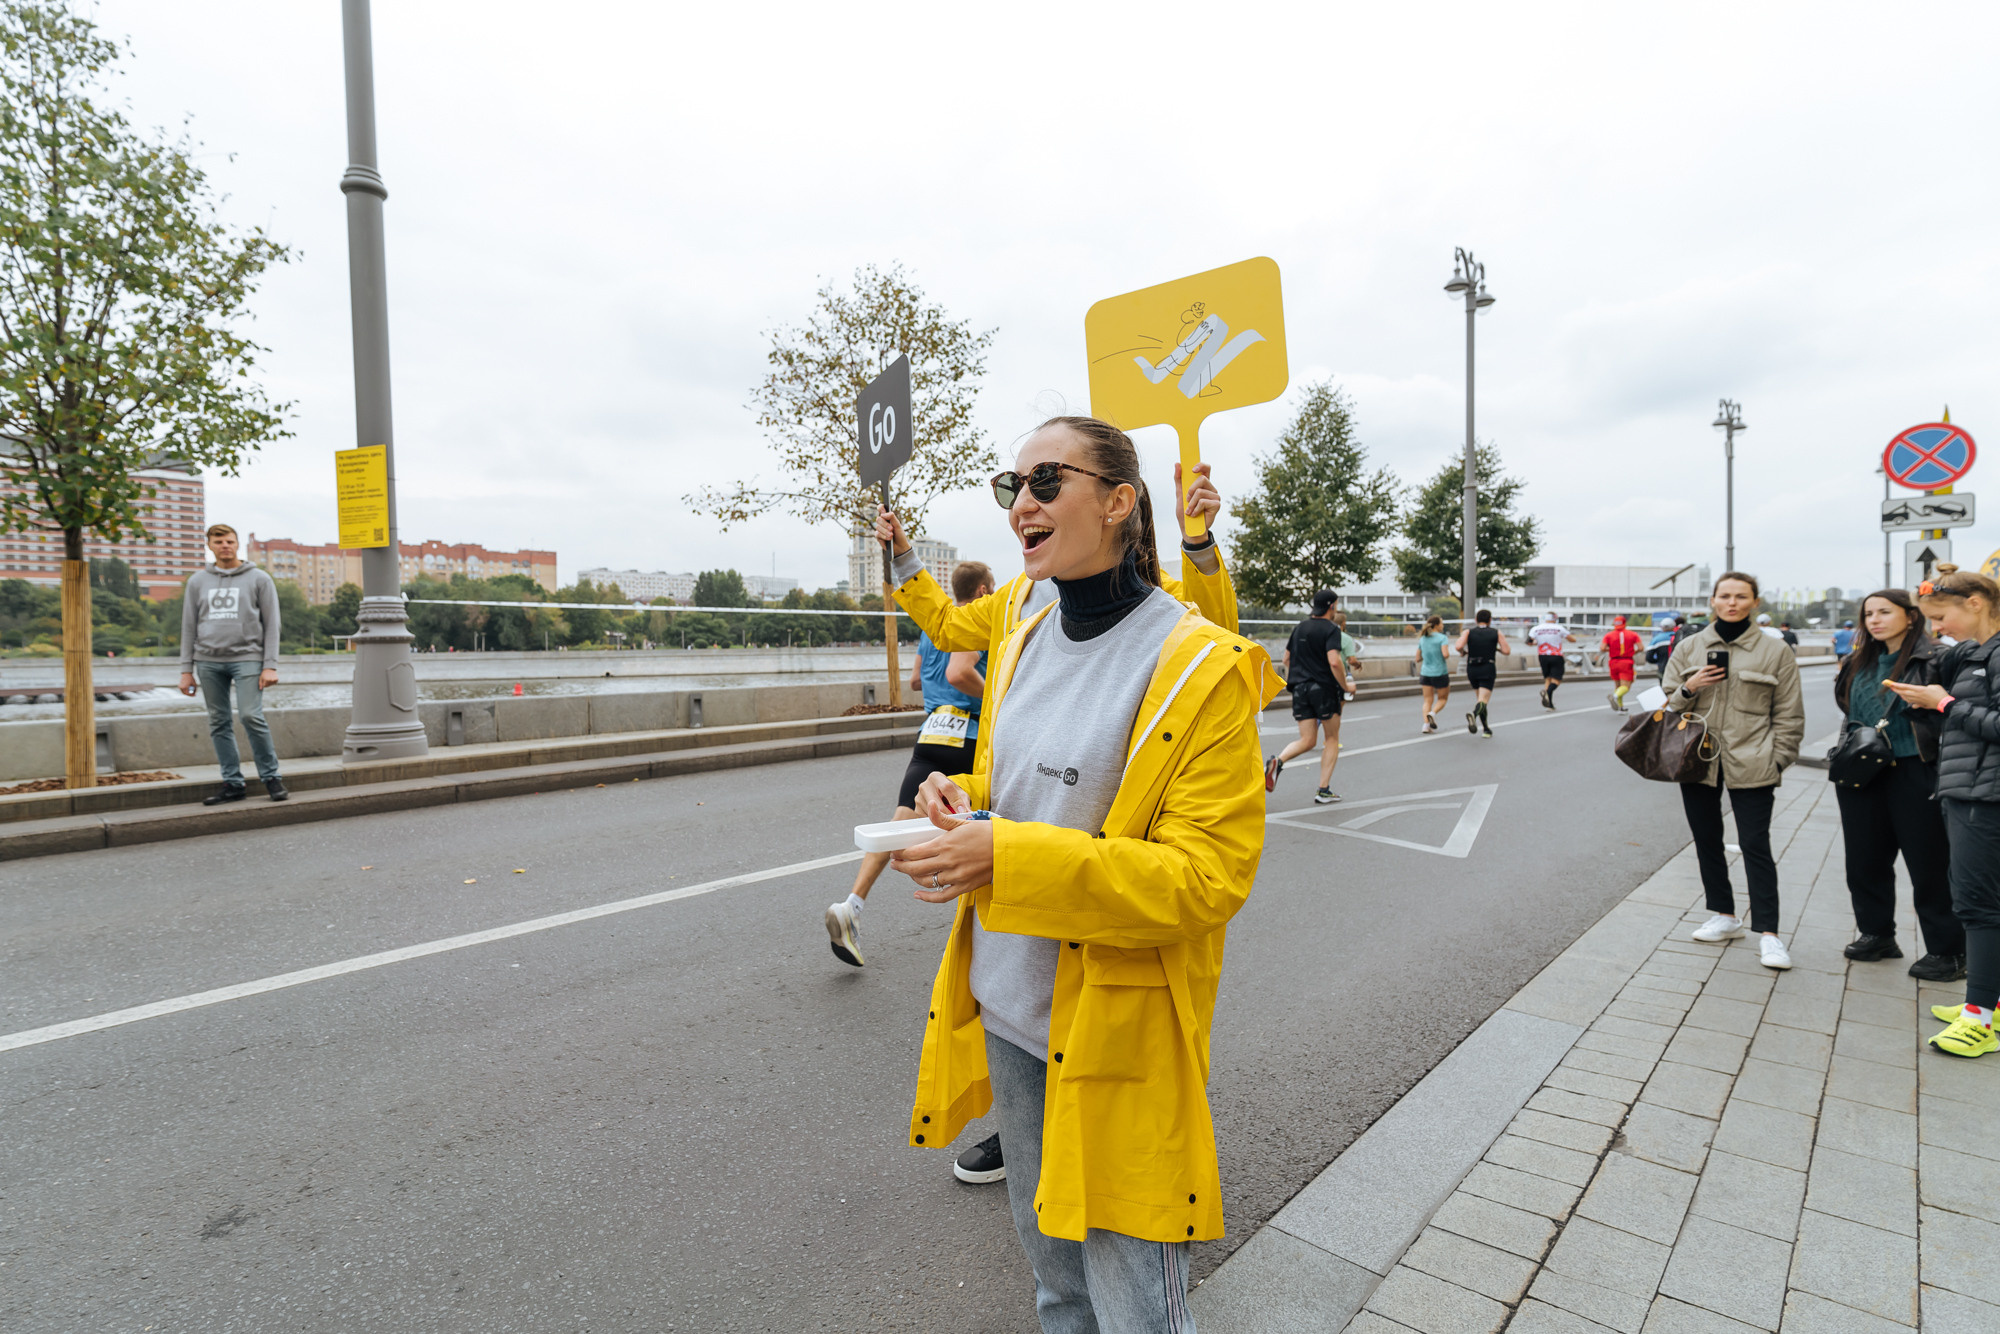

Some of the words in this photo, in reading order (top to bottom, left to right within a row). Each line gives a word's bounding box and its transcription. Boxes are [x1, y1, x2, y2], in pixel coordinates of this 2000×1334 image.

[927, 715, 966, 732] 16447
[1036, 762, 1064, 780] Яндекс
[1064, 770, 1077, 783] Go
